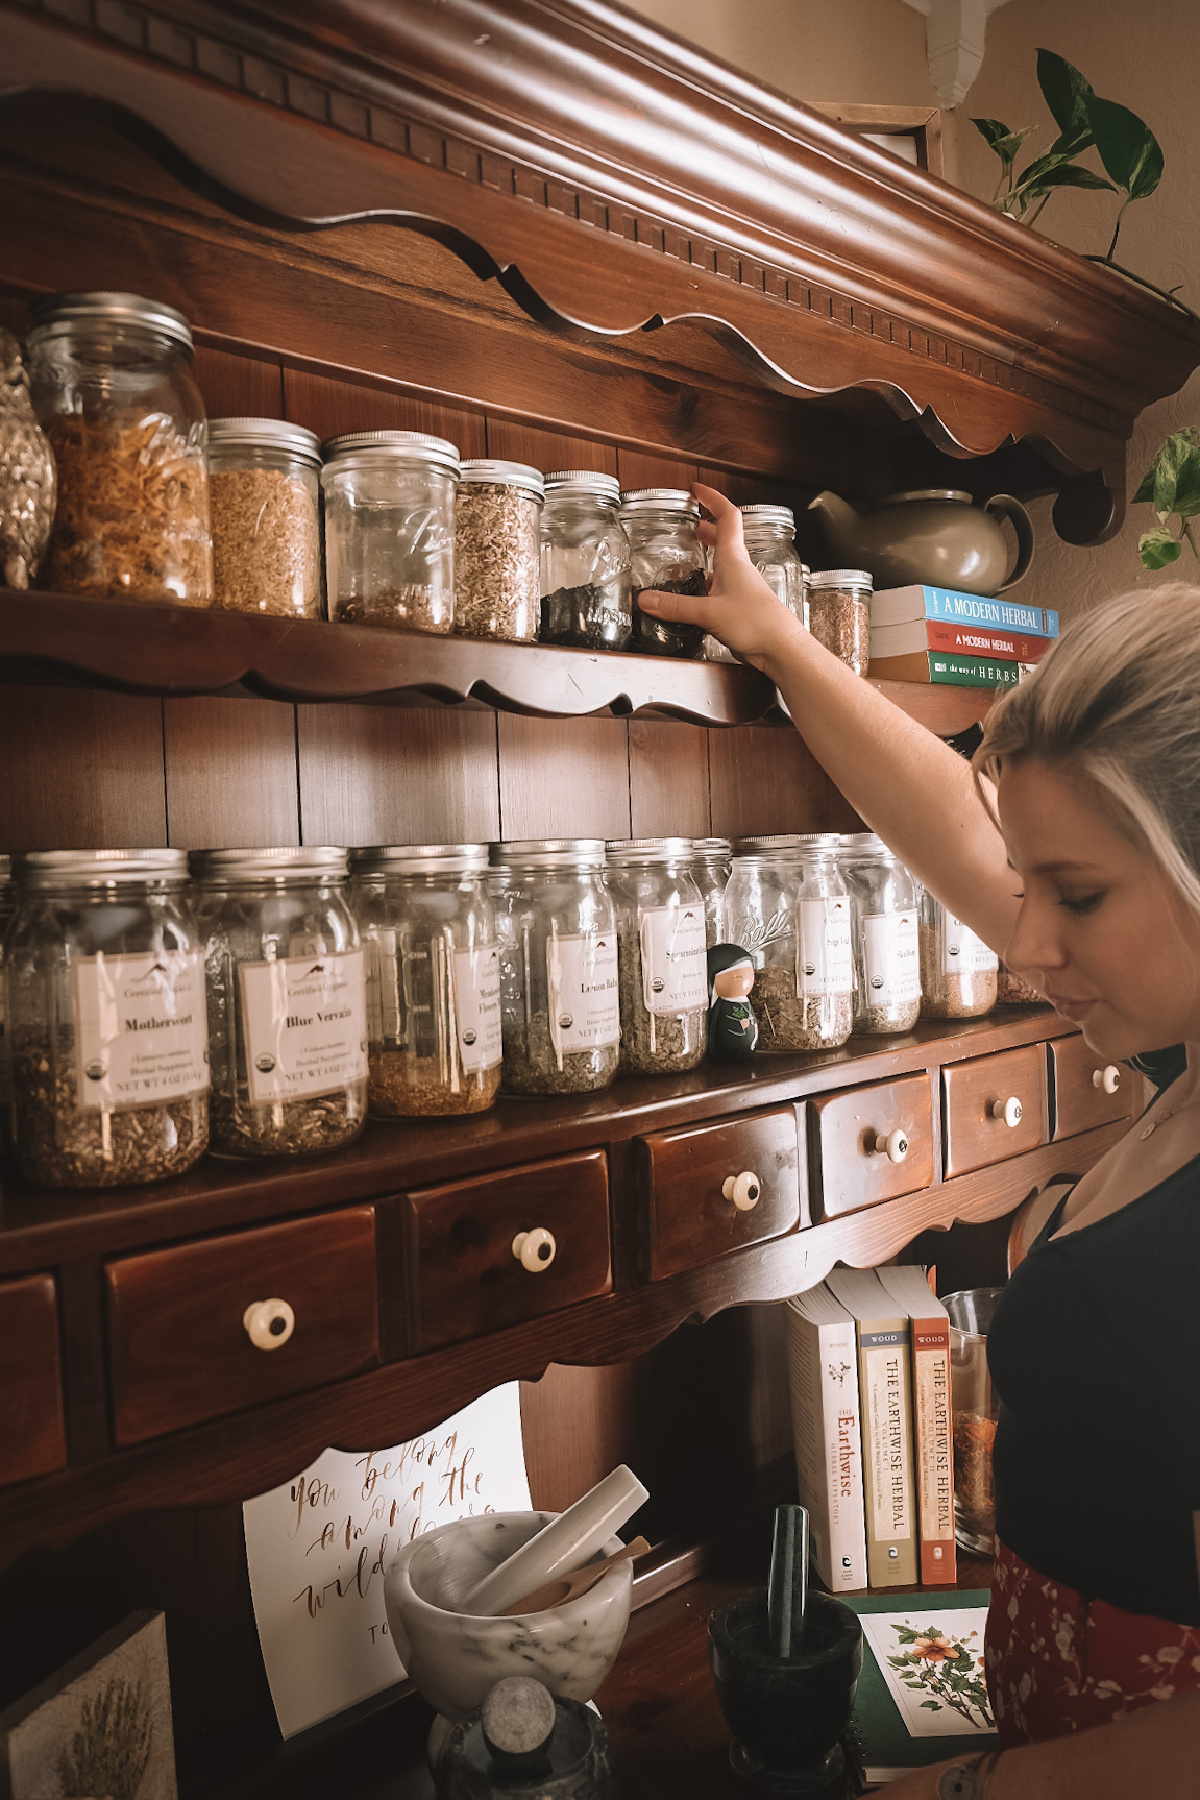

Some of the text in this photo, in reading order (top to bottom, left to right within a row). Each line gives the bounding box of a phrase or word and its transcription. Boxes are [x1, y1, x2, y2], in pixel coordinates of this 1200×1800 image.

[944, 597, 953, 614] A
[954, 598, 1000, 622] MODERN
[1002, 608, 1038, 629] HERBAL
[955, 634, 962, 645] A
[962, 635, 991, 650] MODERN
[991, 639, 1015, 653] HERBAL
[949, 663, 958, 673] the
[125, 1014, 193, 1033] Motherwort
[286, 1005, 352, 1029] Blue Vervain
[871, 1335, 898, 1343] WOOD
[917, 1335, 945, 1343] WOOD
[837, 1415, 856, 1498] Earthwise
[881, 1421, 889, 1462] VOLUME
[886, 1358, 905, 1531] THE EARTHWISE HERBAL
[928, 1419, 936, 1460] VOLUME
[933, 1360, 950, 1531] THE EARTHWISE HERBAL
[286, 1476, 341, 1540] you
[355, 1430, 458, 1501] belong
[305, 1481, 424, 1557] among
[438, 1447, 484, 1506] the
